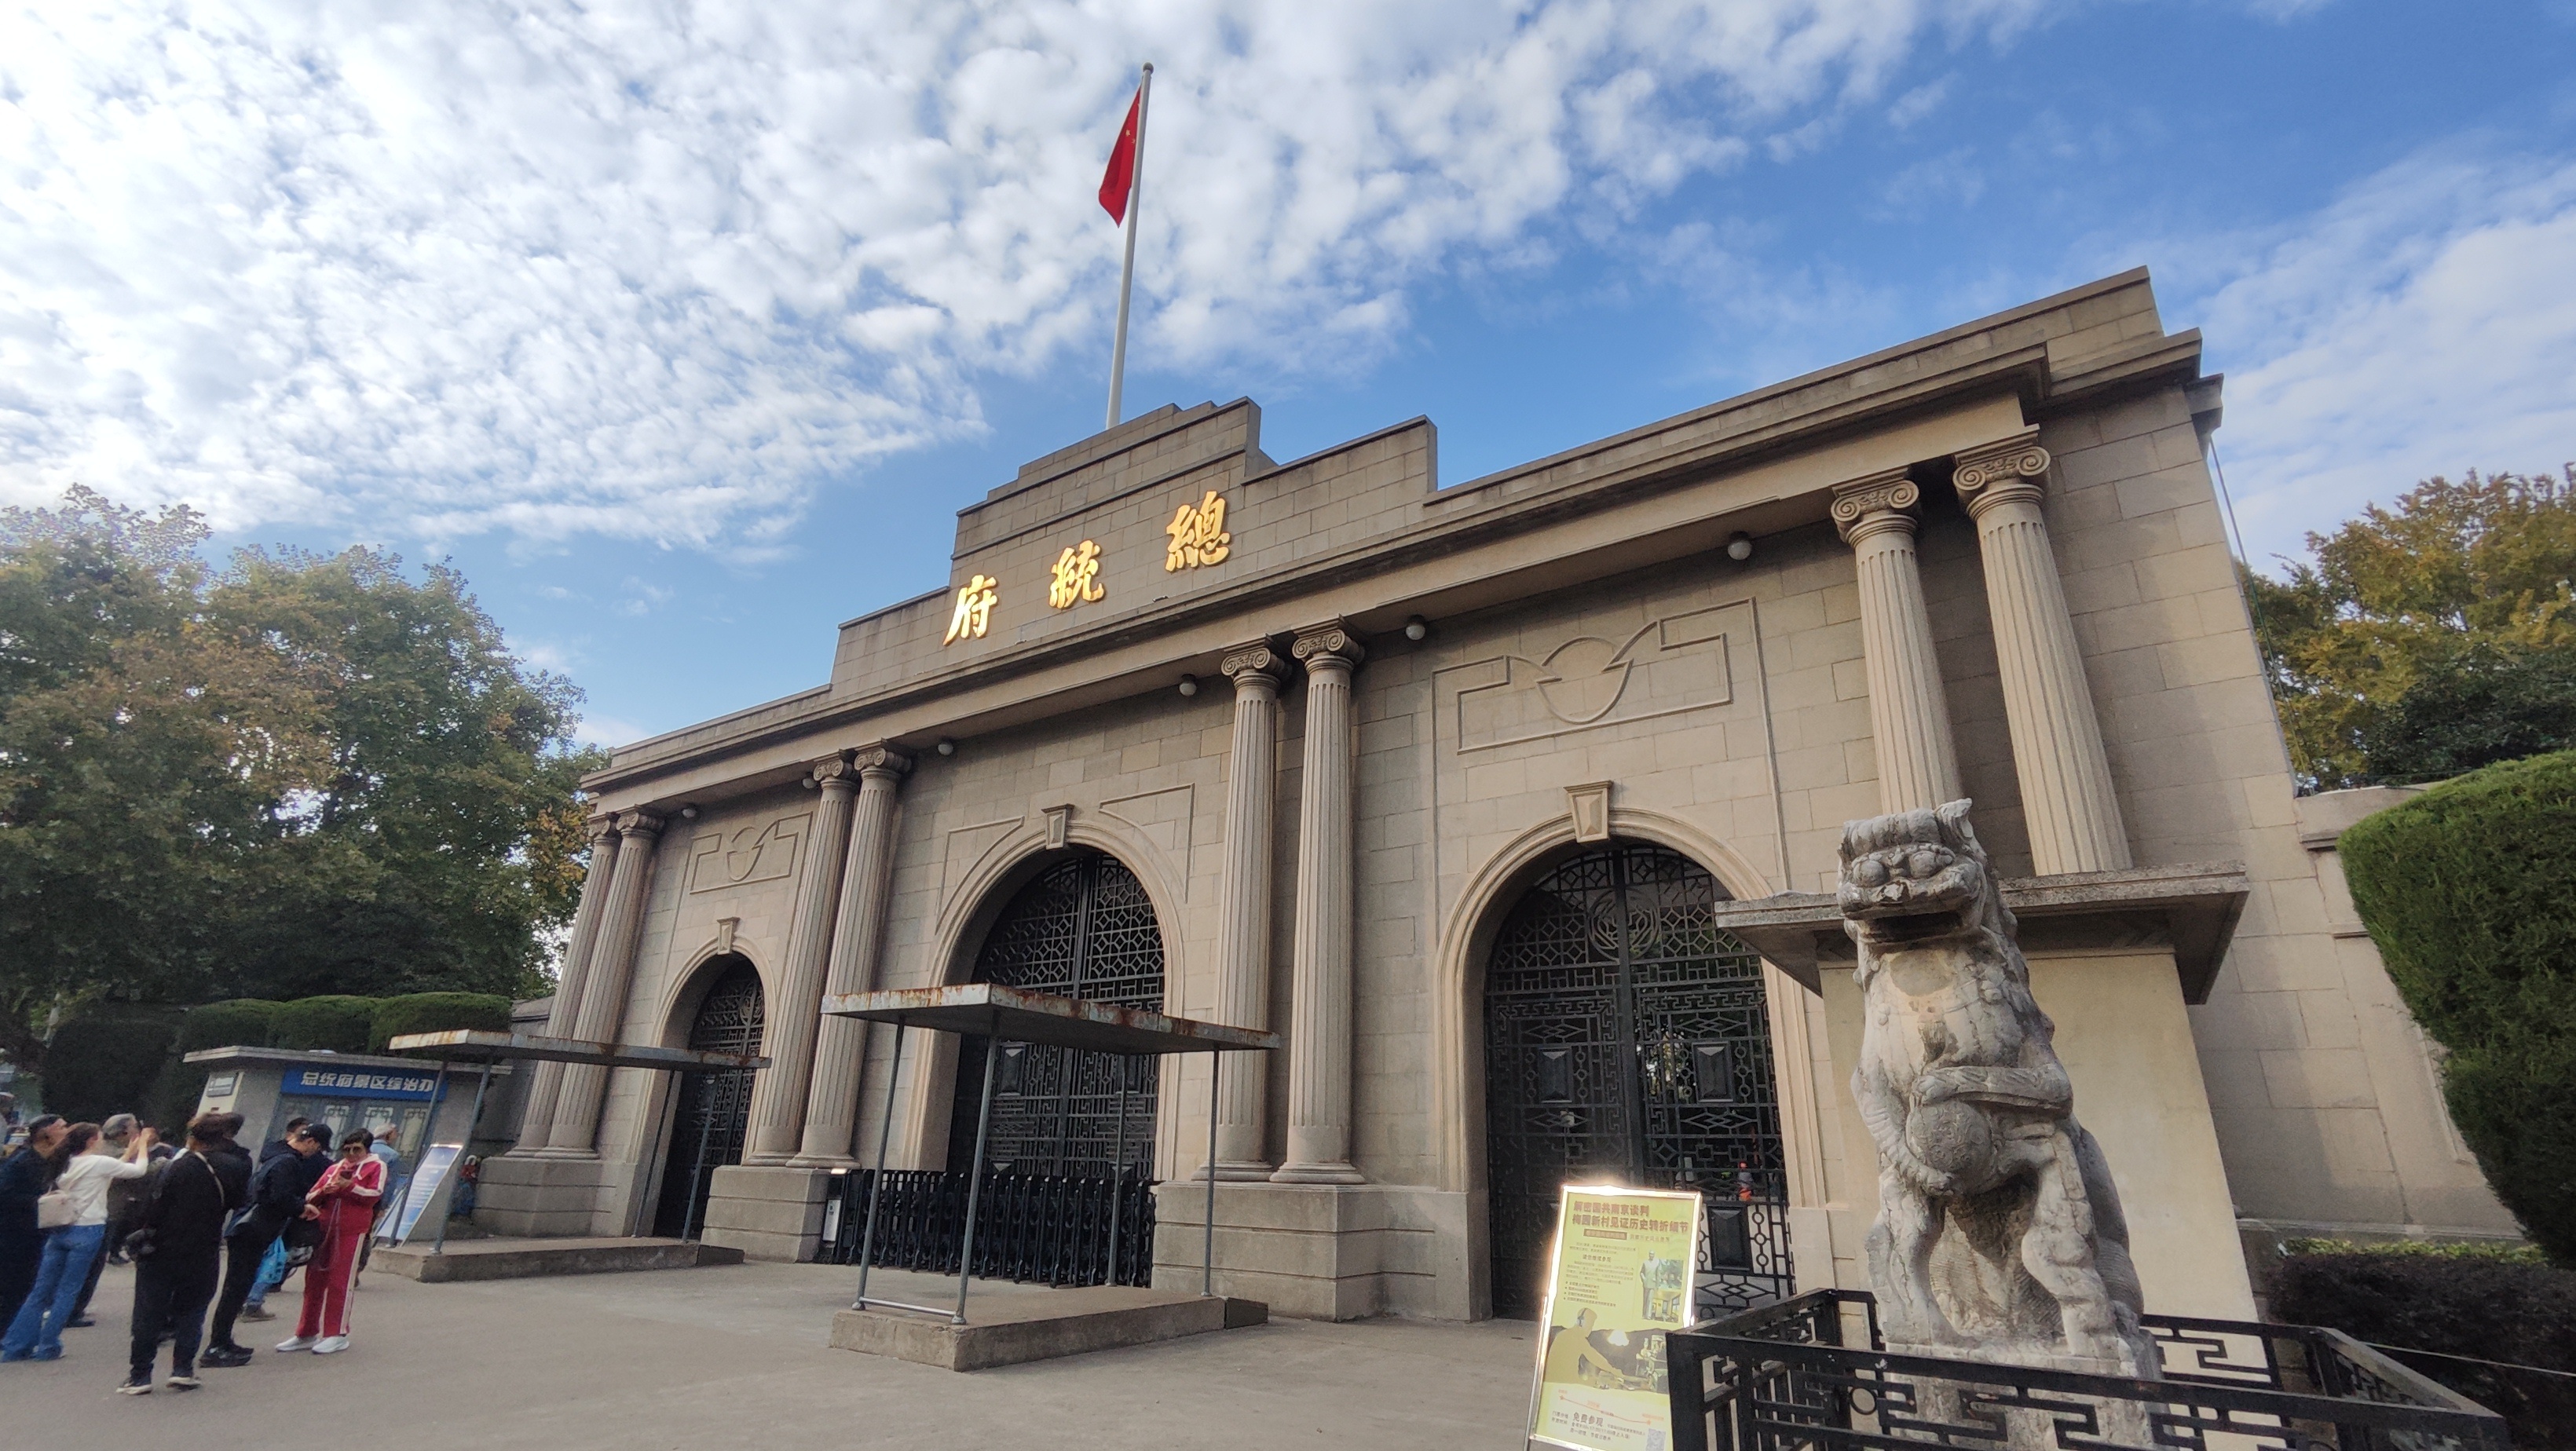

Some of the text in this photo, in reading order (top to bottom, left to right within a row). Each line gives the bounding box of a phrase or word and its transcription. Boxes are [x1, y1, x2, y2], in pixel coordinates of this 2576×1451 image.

[942, 489, 1231, 646] 總統府
[301, 1072, 434, 1092] 总统府景区综治办
[1573, 1412, 1604, 1427] 免费参观
